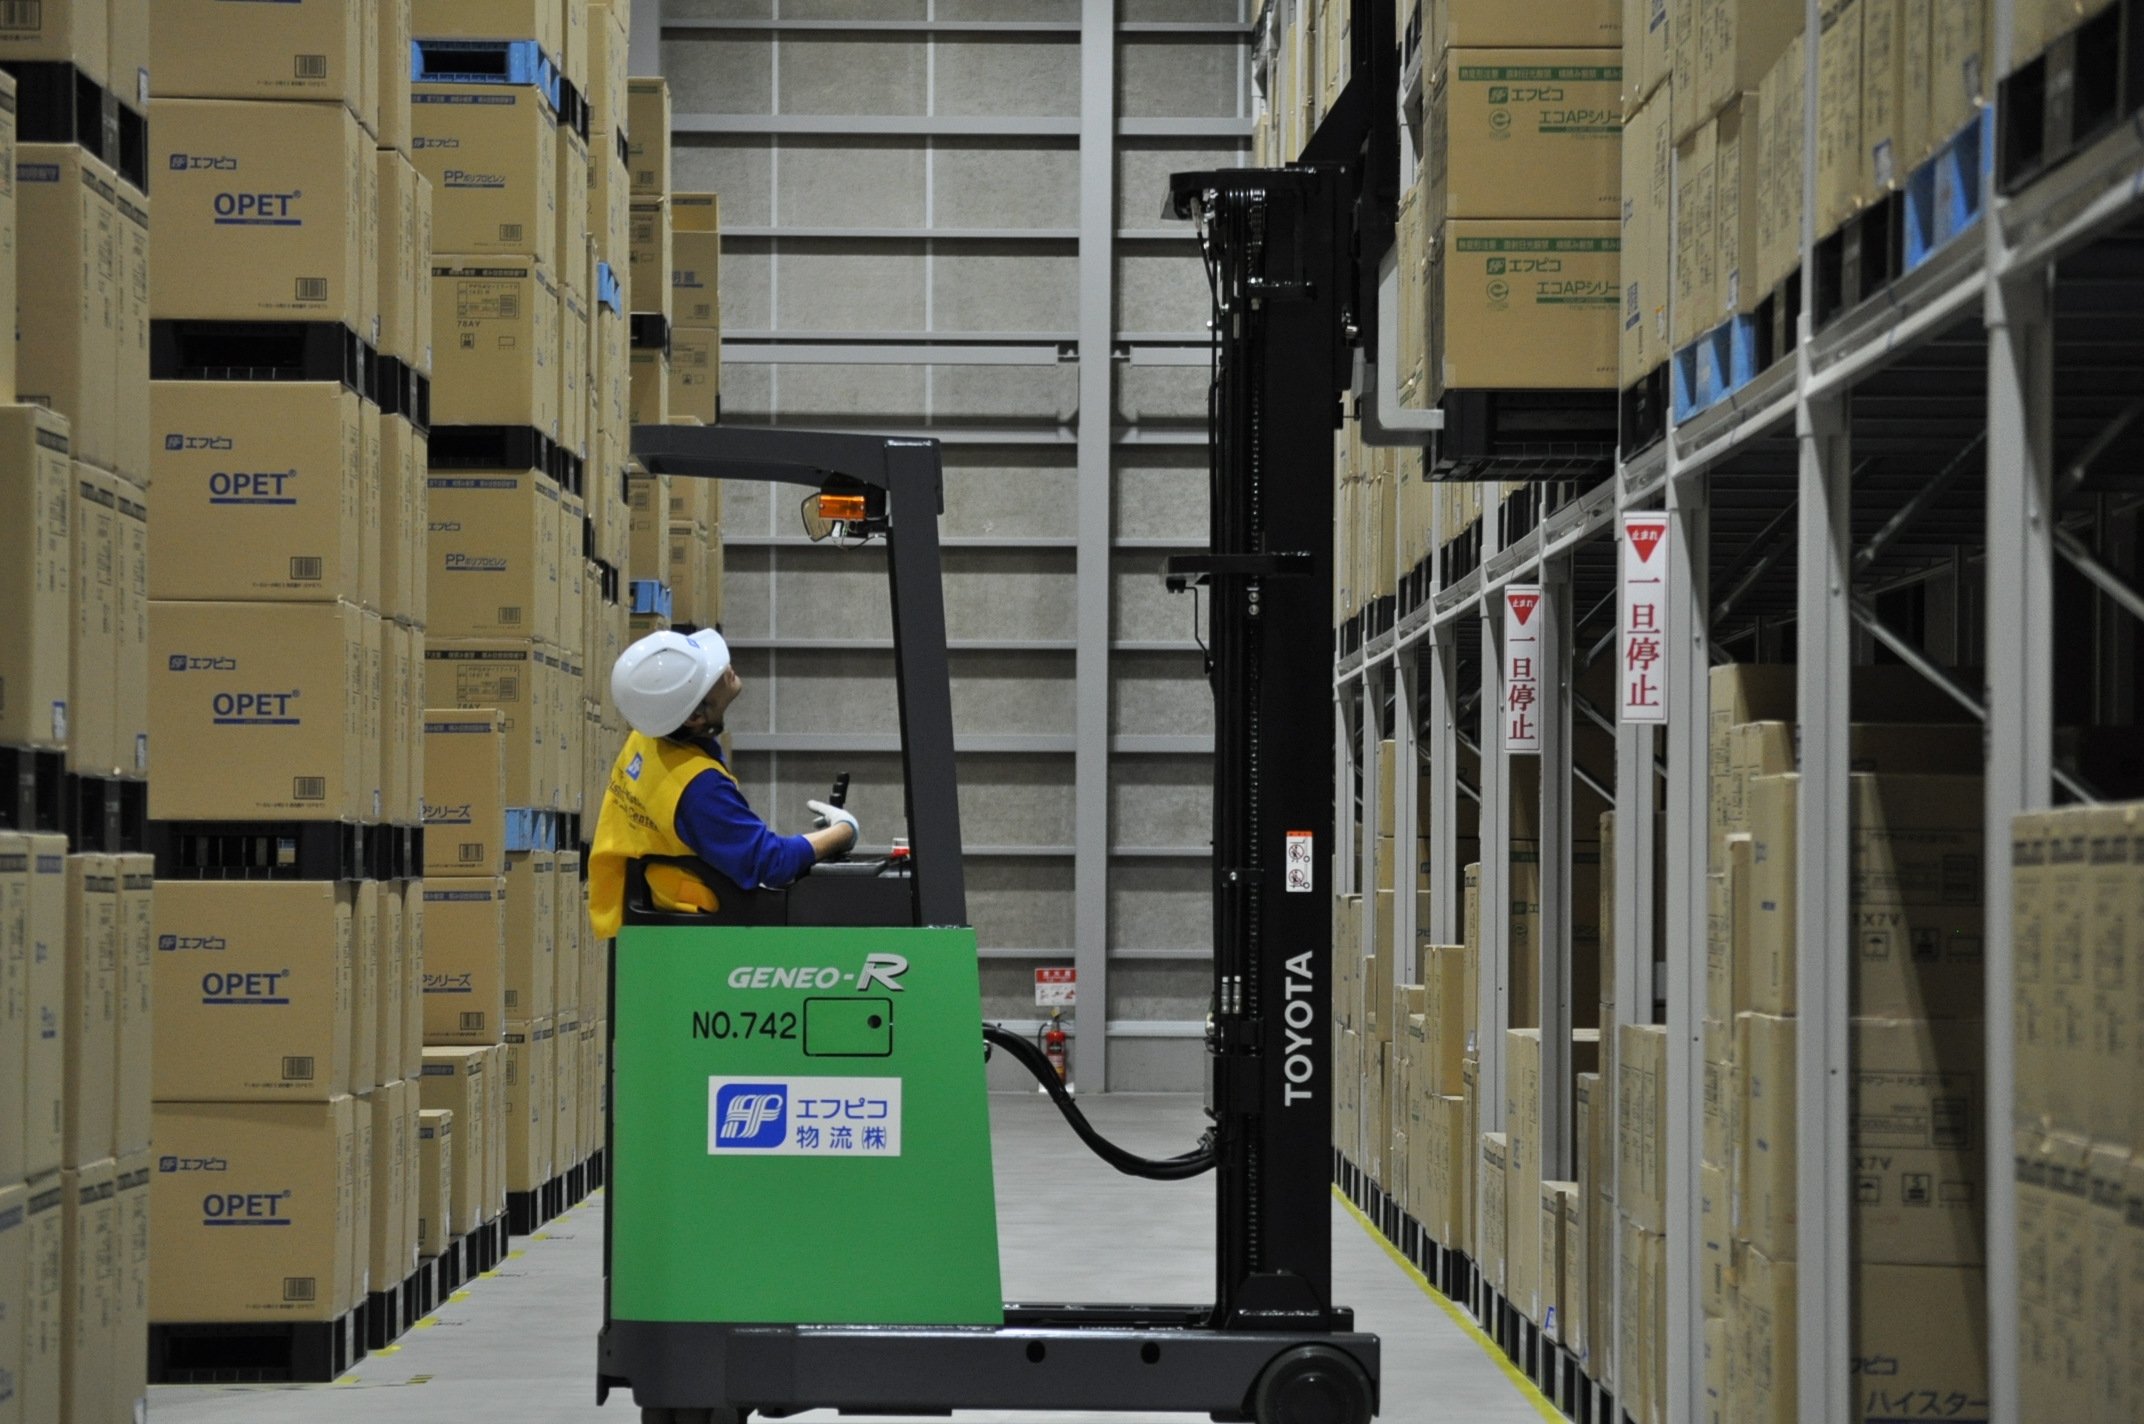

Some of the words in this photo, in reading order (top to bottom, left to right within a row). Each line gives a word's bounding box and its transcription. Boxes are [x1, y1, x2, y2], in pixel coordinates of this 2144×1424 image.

[1512, 86, 1563, 102] エフピコ
[190, 156, 237, 171] エフピコ
[1509, 257, 1562, 273] エフピコ
[185, 436, 233, 451] エフピコ
[1631, 531, 1659, 543] 止まれ
[1511, 599, 1535, 609] 止まれ
[1626, 576, 1661, 708] 一旦停止
[189, 656, 236, 671] エフピコ
[1508, 636, 1537, 741] 一旦停止
[179, 935, 226, 950] エフピコ
[728, 953, 908, 991] GENEO-R
[692, 1010, 797, 1040] NO.742
[1285, 951, 1314, 1107] TOYOTA
[796, 1097, 887, 1120] エフピコ
[179, 1156, 227, 1172] エフピコ
